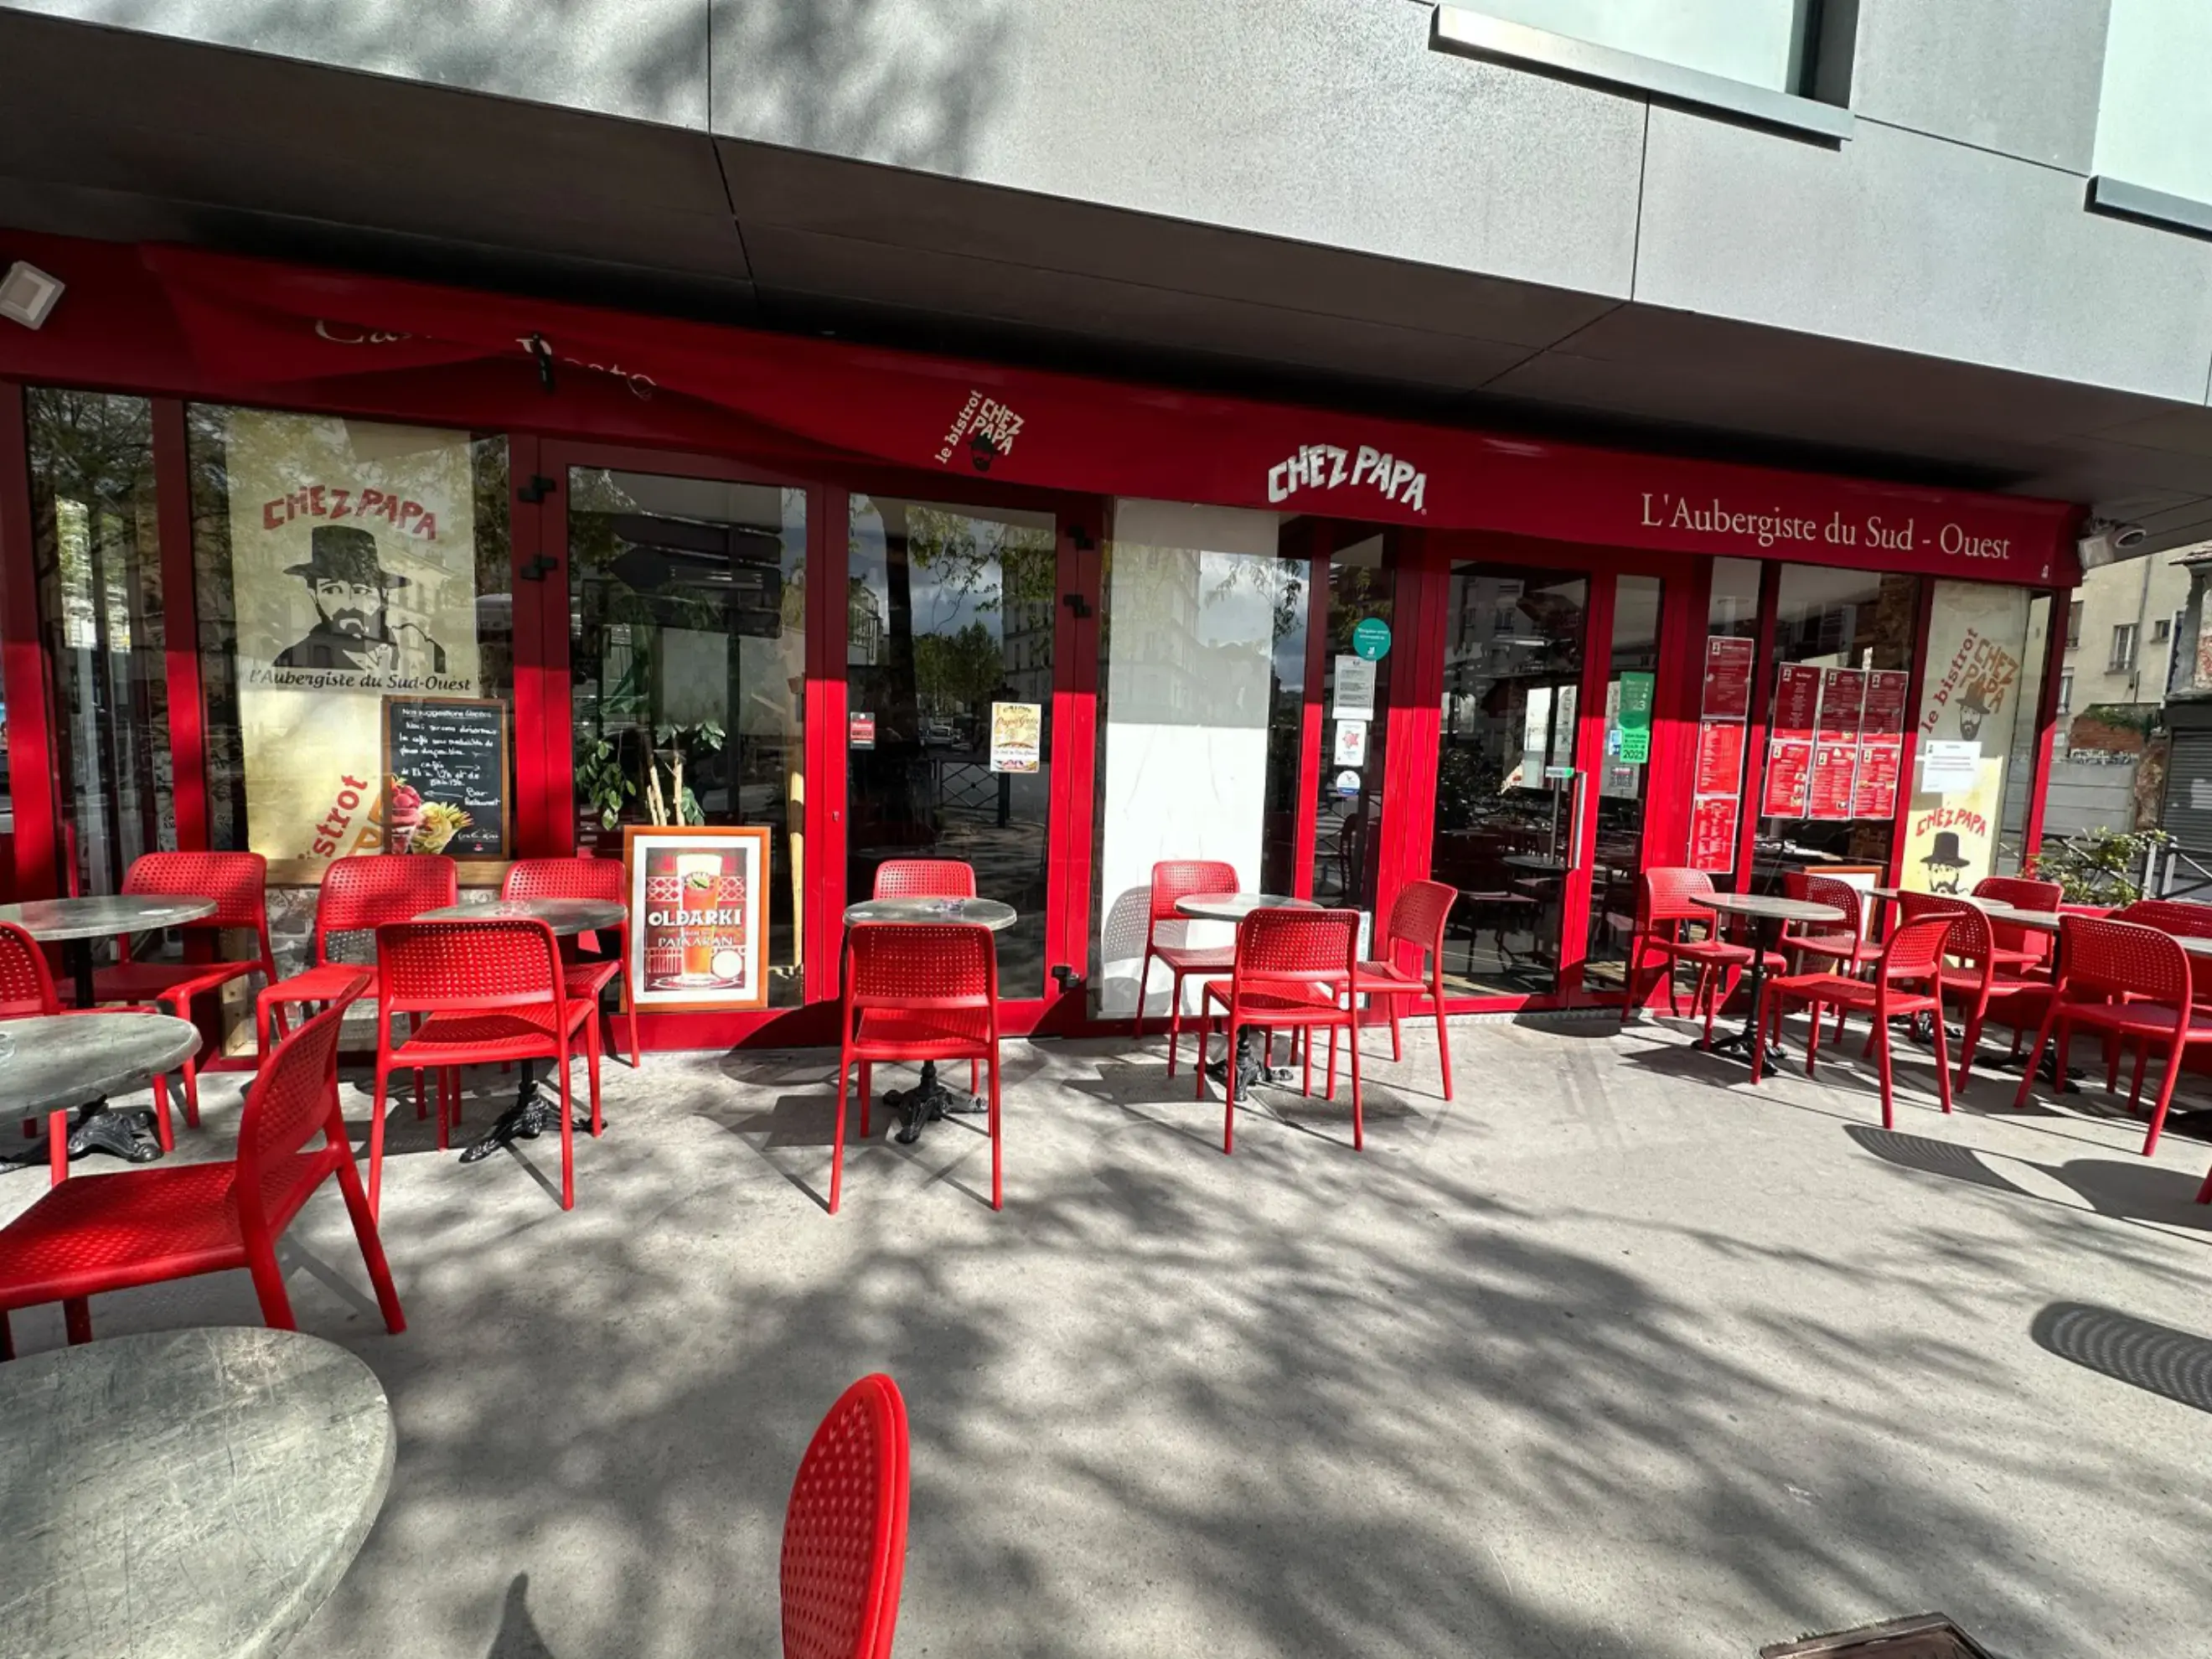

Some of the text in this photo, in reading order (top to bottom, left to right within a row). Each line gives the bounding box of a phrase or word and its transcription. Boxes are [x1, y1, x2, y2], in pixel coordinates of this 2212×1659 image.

[934, 390, 983, 464] le bistrot
[968, 415, 1013, 456] PAPA
[980, 398, 1025, 435] CHEZ
[1268, 443, 1427, 512] CHEZ PAPA
[263, 484, 437, 540] CHEZ PAPA
[1641, 493, 1817, 547] L'Aubergiste
[1824, 511, 1857, 545] du
[1865, 515, 1914, 550] Sud
[1940, 523, 2011, 560] Ouest
[249, 669, 472, 691] l'Aubergiste du Sud-Ouest
[1920, 711, 1939, 734] le
[1933, 628, 1978, 706] bistrot
[1974, 638, 2019, 685] CHEZ
[1958, 663, 2005, 714] PAPA
[1915, 807, 1987, 837] CHEZ PAPA
[648, 909, 742, 926] OLDARKI
